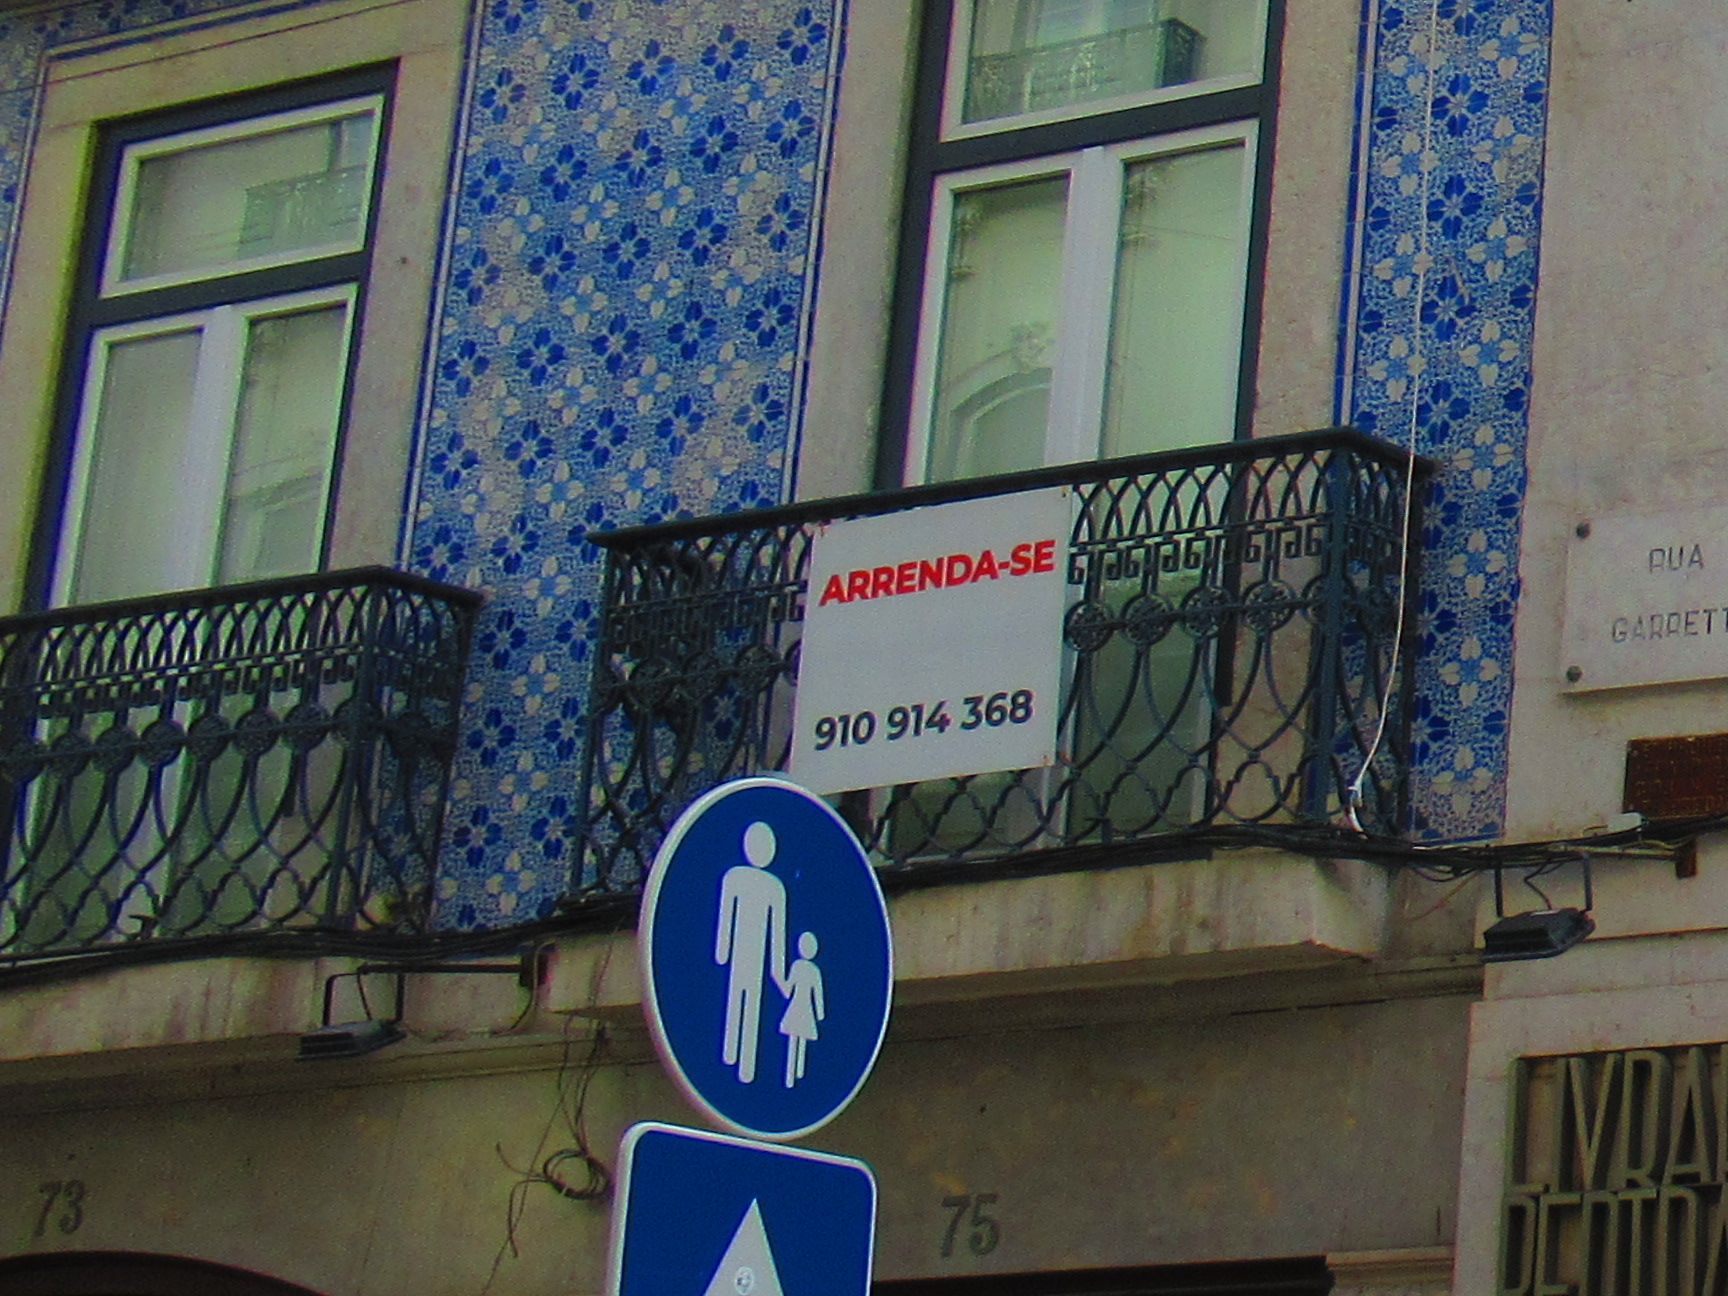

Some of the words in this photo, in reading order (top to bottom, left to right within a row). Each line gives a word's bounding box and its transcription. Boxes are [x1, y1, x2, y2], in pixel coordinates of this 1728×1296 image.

[818, 539, 1056, 606] ARRENDA-SE
[1647, 543, 1705, 575] RUA
[814, 710, 876, 751] 910
[886, 700, 951, 741] 914
[960, 689, 1034, 731] 368
[33, 1178, 86, 1237] 73
[940, 1193, 999, 1258] 75
